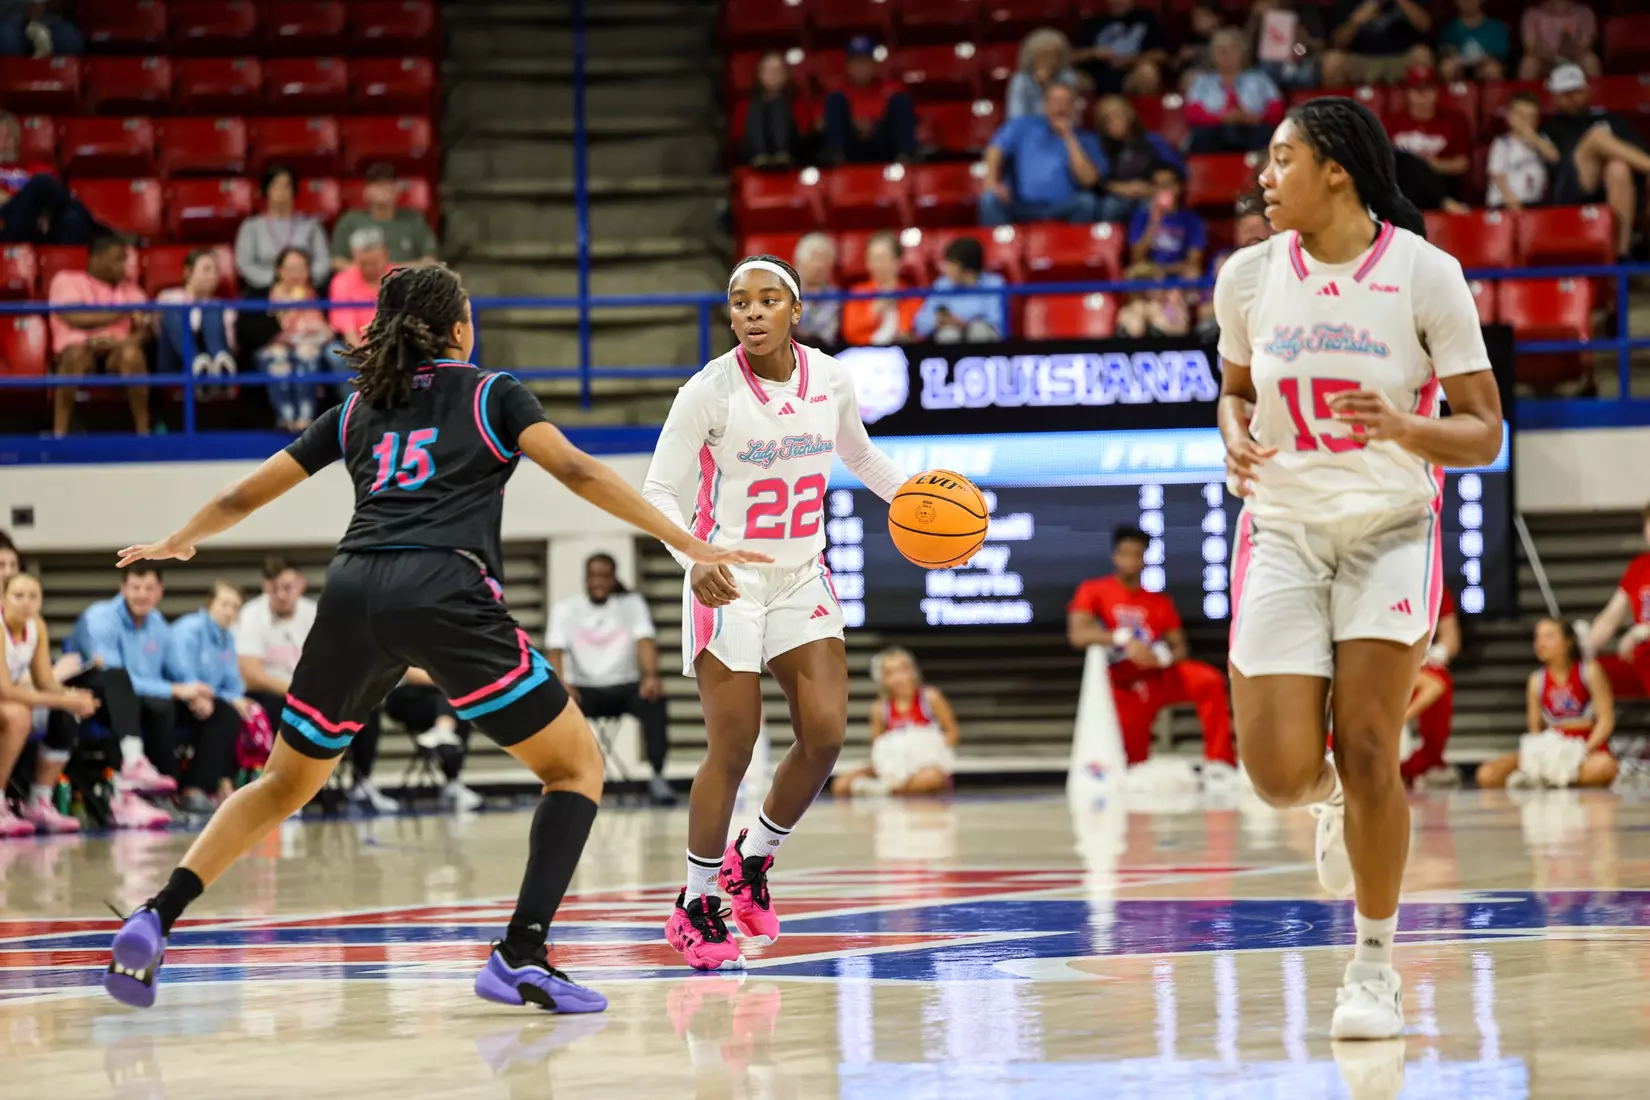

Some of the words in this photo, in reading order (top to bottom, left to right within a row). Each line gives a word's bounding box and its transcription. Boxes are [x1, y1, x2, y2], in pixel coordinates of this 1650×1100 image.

[920, 350, 1219, 410] LOUISIANA
[1277, 377, 1369, 454] 15
[369, 427, 439, 496] 15
[737, 439, 778, 470] Lady
[777, 432, 834, 461] Techsters
[743, 473, 827, 539] 22
